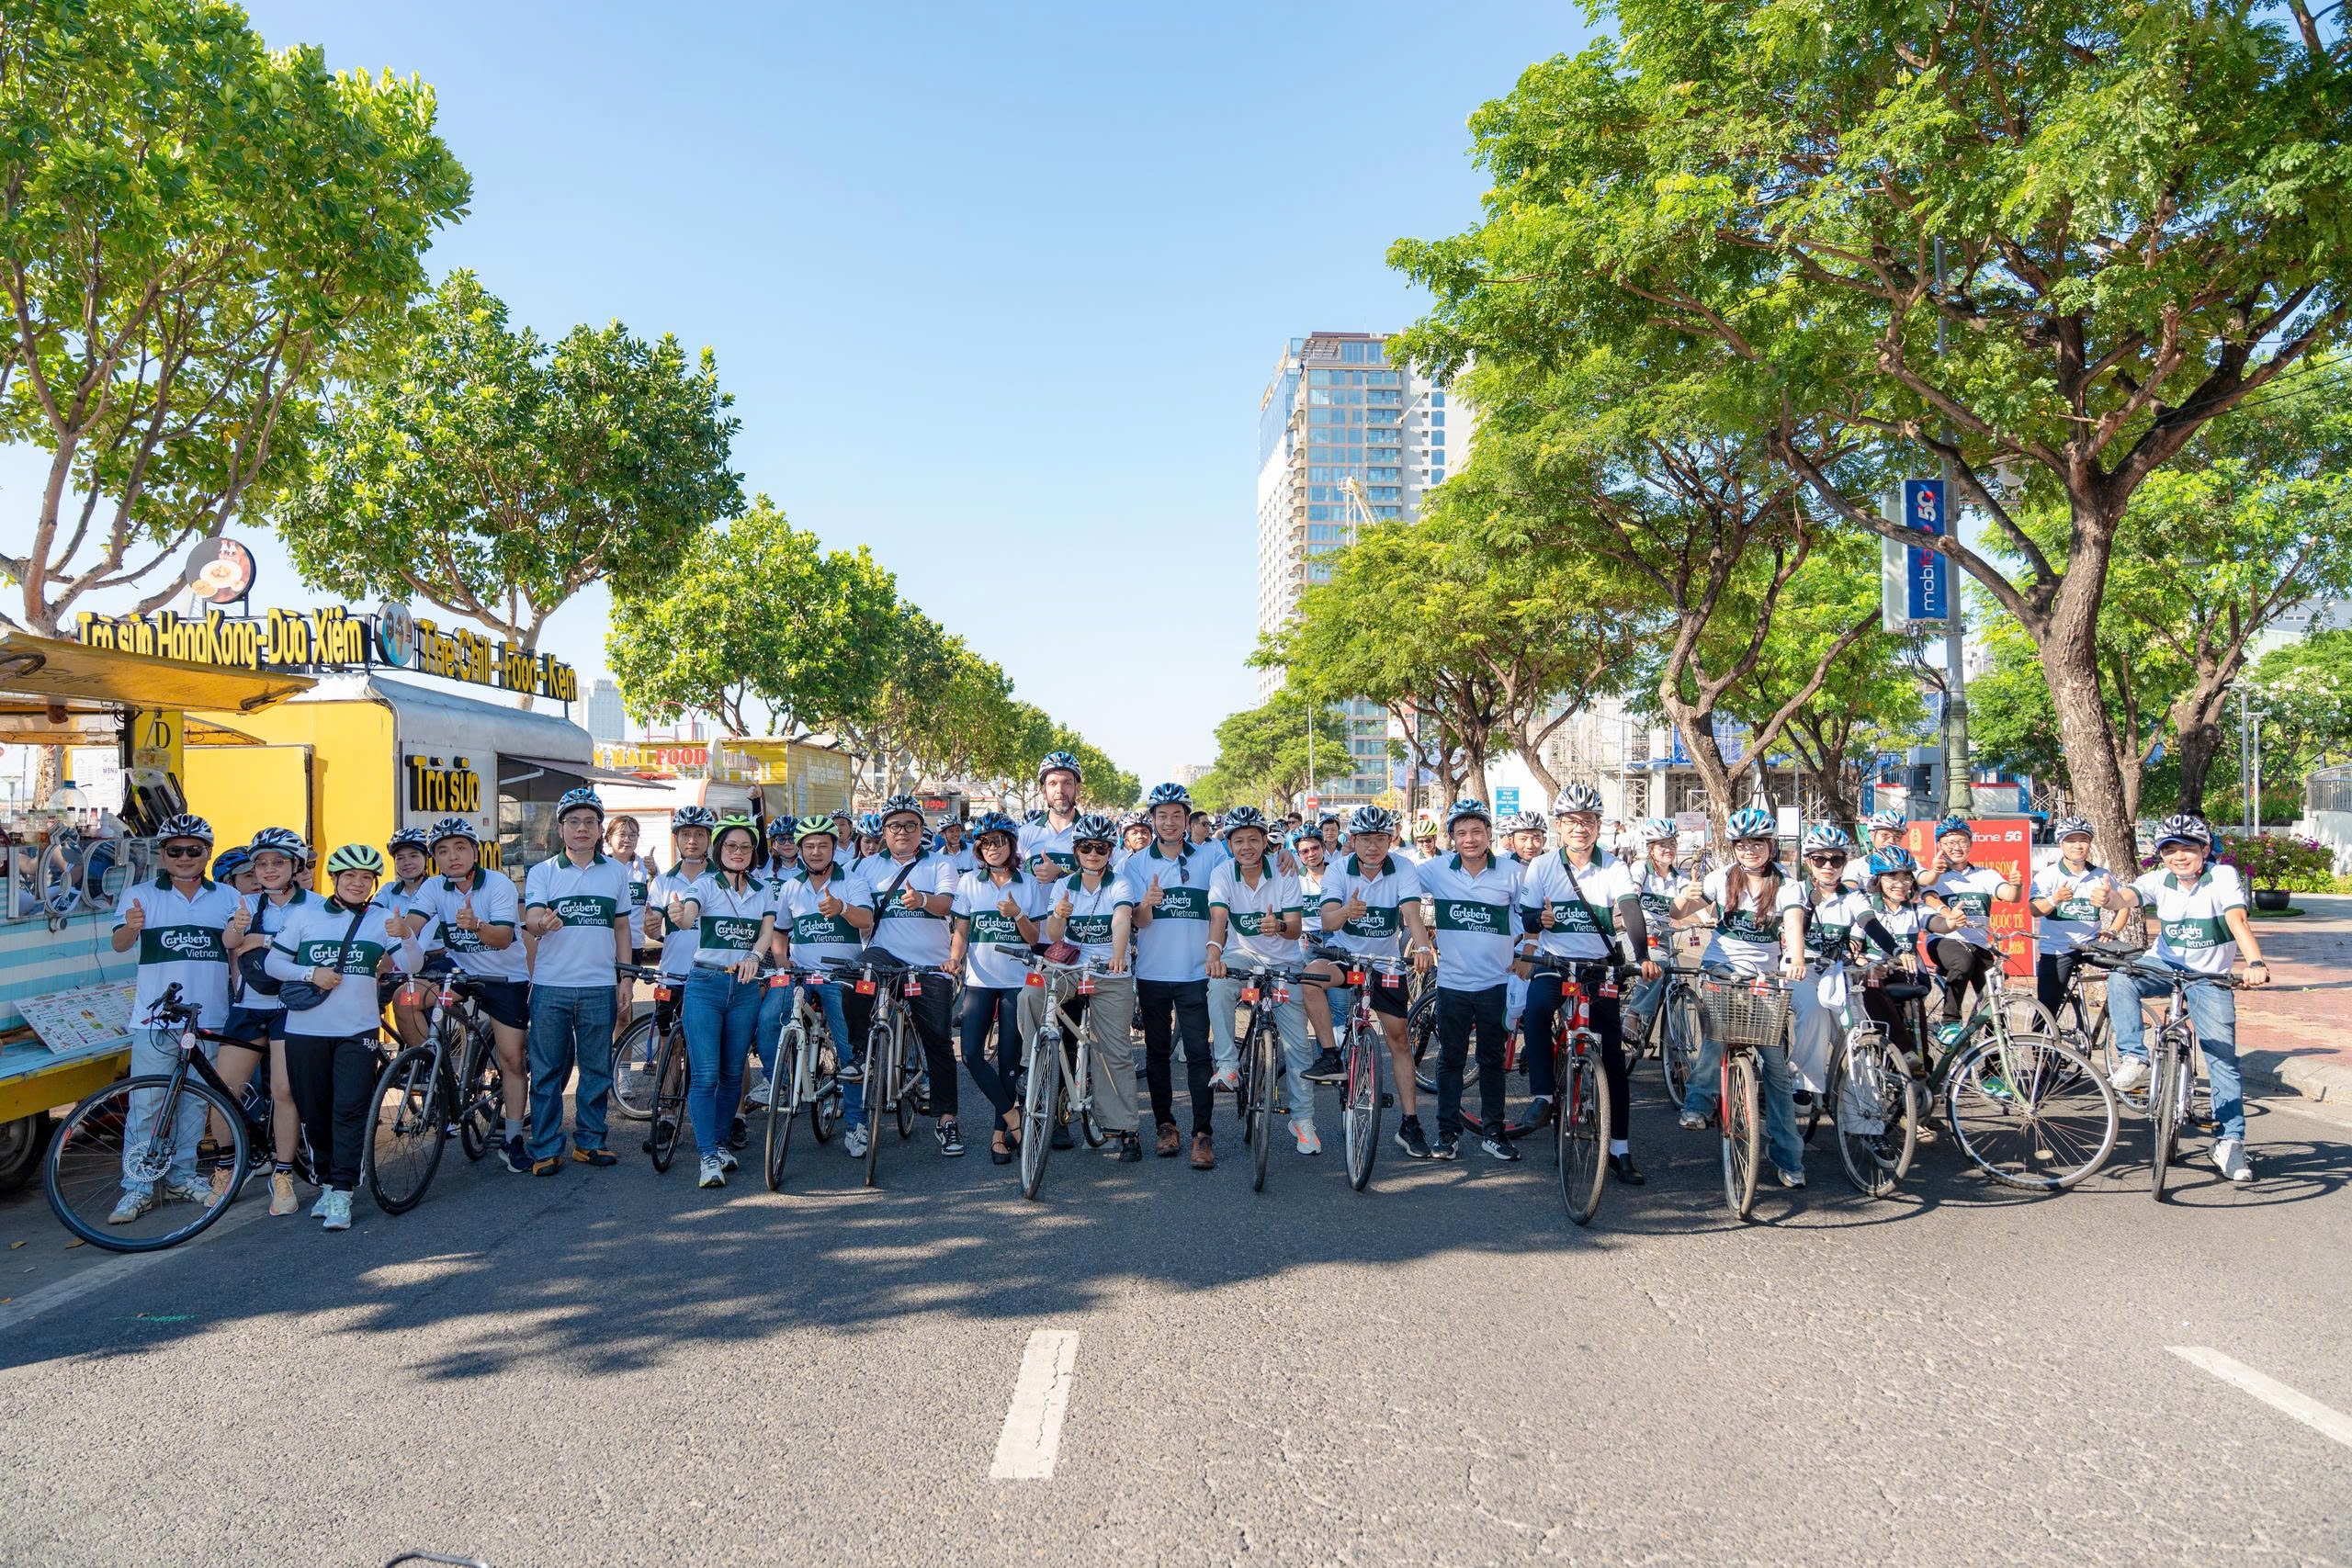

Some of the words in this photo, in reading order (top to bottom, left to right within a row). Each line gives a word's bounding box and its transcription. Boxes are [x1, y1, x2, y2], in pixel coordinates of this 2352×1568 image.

[1917, 491, 1937, 522] 5G
[312, 604, 363, 664] Xiêm
[419, 619, 455, 678] The
[458, 627, 492, 684] Chill
[504, 641, 537, 694] Food
[548, 653, 579, 702] Kem
[655, 748, 707, 765] FOOD
[2004, 830, 2022, 842] 5G
[558, 899, 602, 918] Carlsberg
[893, 909, 925, 918] Vietnam
[1170, 908, 1200, 918] Vietnam
[1450, 904, 1491, 924] Carlsberg
[715, 920, 755, 941] Carlsberg
[799, 919, 834, 937] Carlsberg
[975, 914, 1016, 933] Carlsberg
[1363, 927, 1394, 937] Vietnam
[1467, 922, 1498, 933] Vietnam
[161, 929, 211, 952] Carlsberg
[813, 934, 845, 942] Vietnam
[1737, 931, 1772, 942] Vietnam
